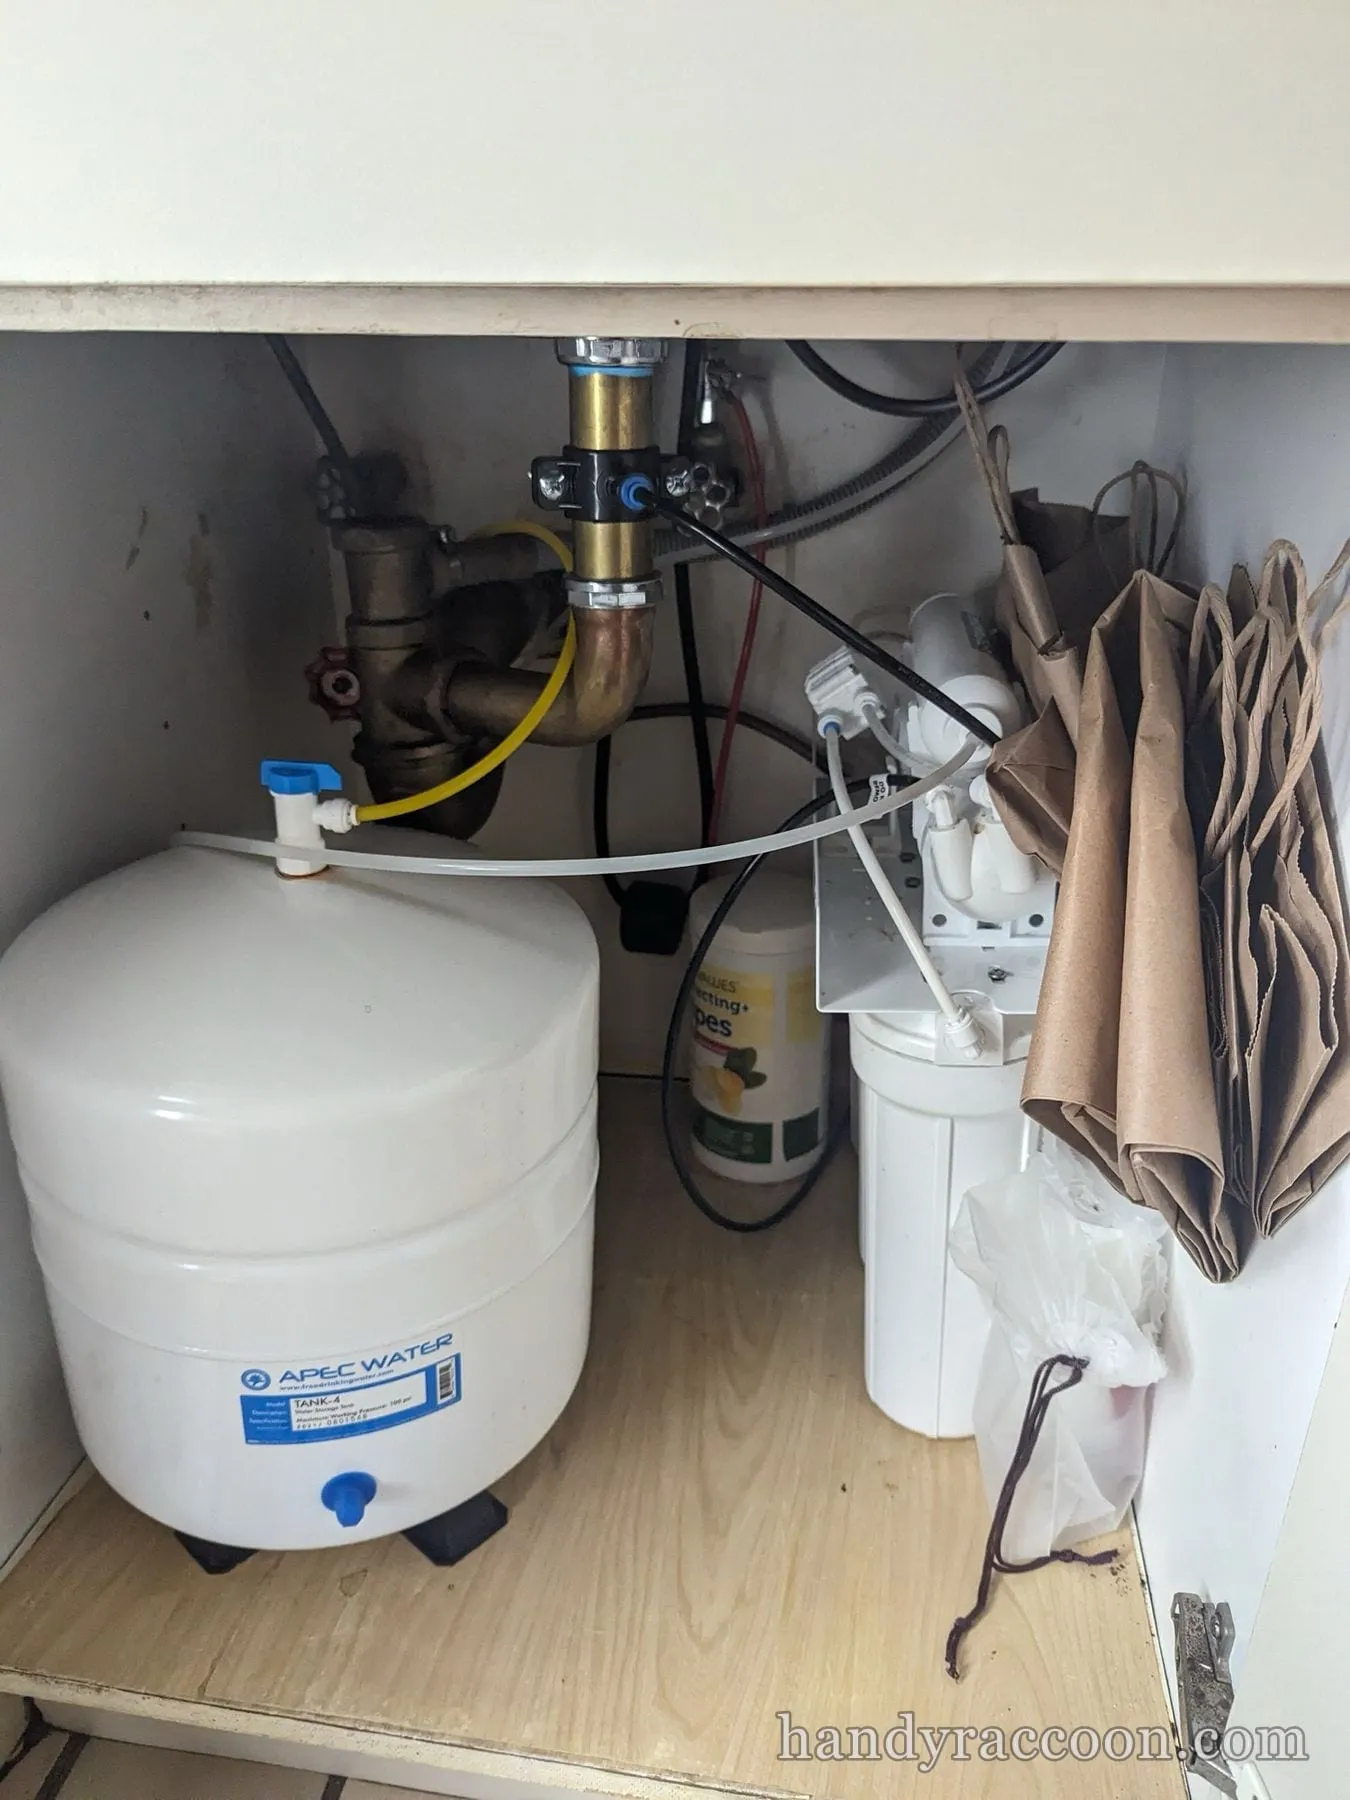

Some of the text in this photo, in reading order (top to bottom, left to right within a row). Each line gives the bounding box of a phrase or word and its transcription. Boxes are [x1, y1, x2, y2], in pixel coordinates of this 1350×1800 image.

[278, 1332, 453, 1384] APEC WATER
[294, 1395, 341, 1408] TANK-4
[330, 1410, 357, 1420] Working
